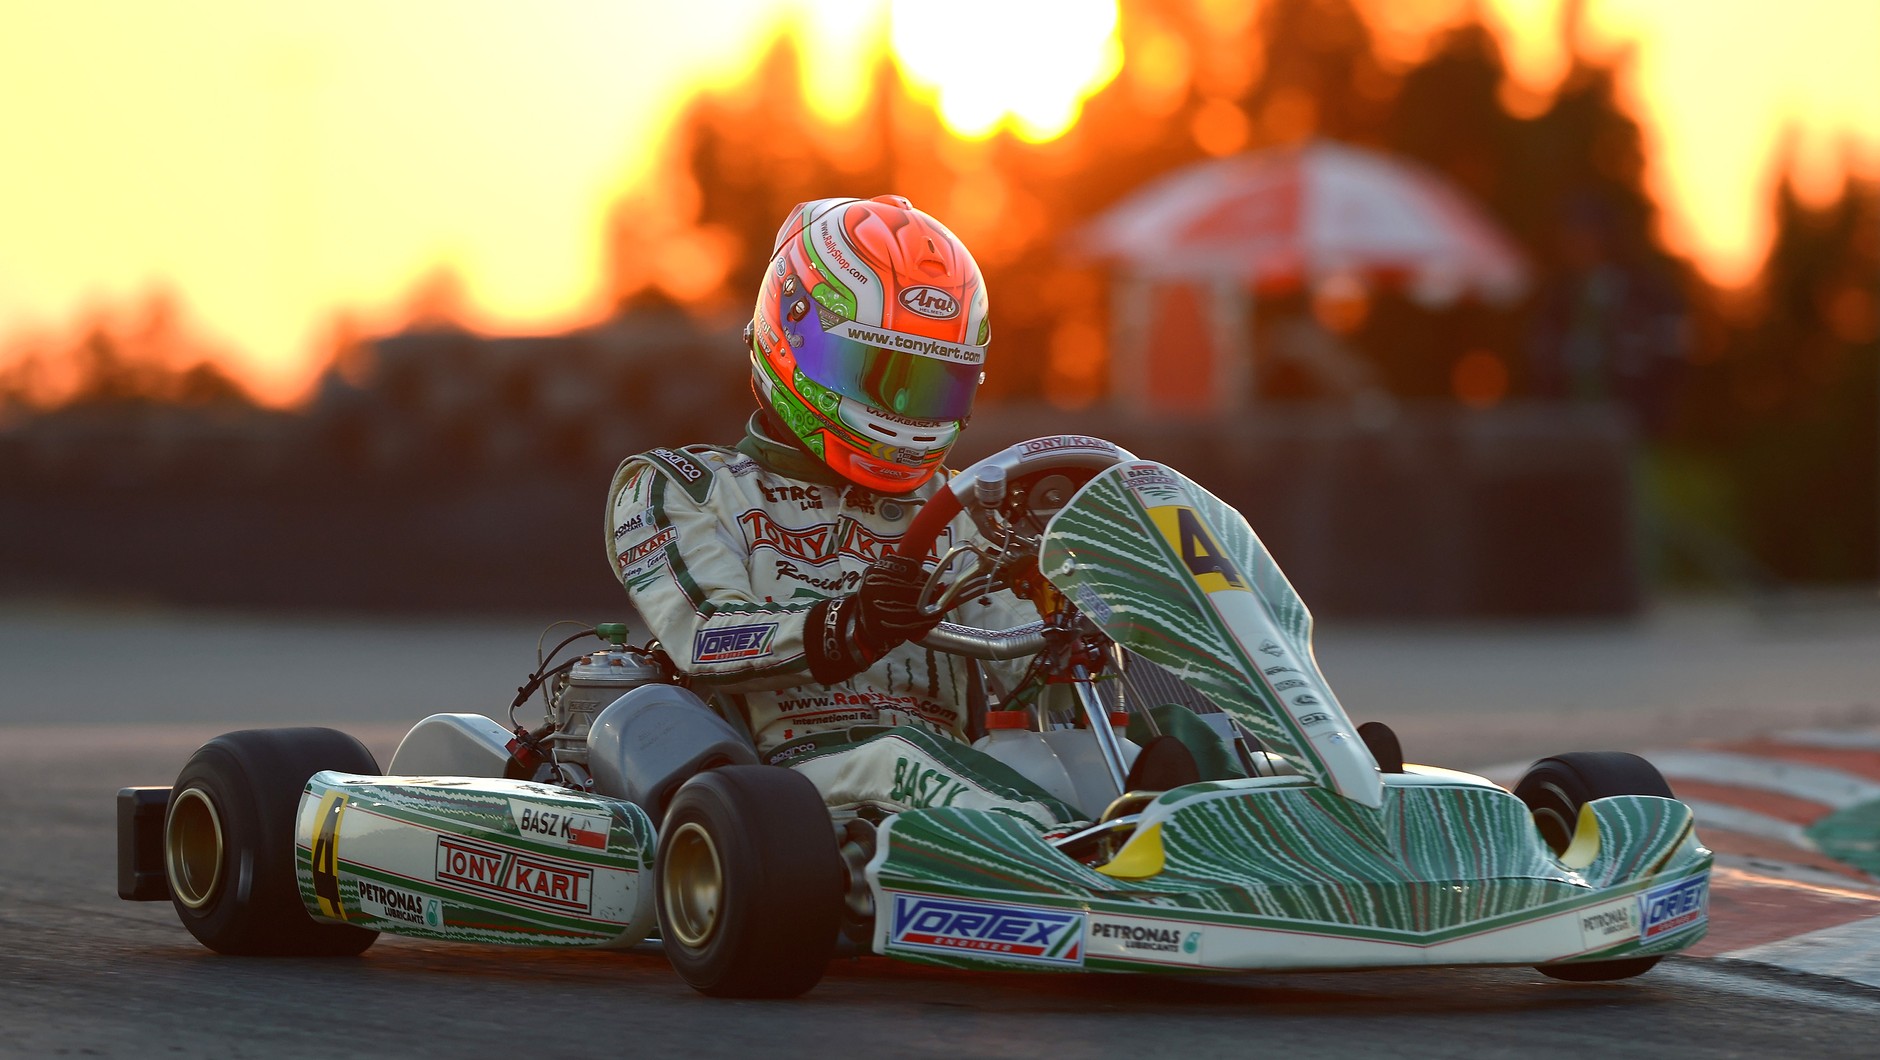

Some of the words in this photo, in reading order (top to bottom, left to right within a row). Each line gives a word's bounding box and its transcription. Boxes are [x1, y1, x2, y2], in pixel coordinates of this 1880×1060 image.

[821, 220, 868, 284] www.RallyShop.com
[847, 326, 981, 363] www.tonykart.com
[743, 511, 828, 558] TONY
[1177, 508, 1244, 588] 4
[698, 626, 770, 655] VORTEX
[792, 712, 858, 725] International
[770, 742, 816, 765] sparco
[521, 809, 559, 837] BASZ
[312, 796, 344, 919] 4
[439, 841, 502, 884] TONY
[515, 859, 589, 902] KART
[358, 880, 423, 914] PETRONAS
[384, 906, 424, 925] LUBRICANTS
[896, 896, 1073, 946] VORTEX
[1092, 921, 1181, 944] PETRONAS
[934, 936, 1013, 952] ENGINES
